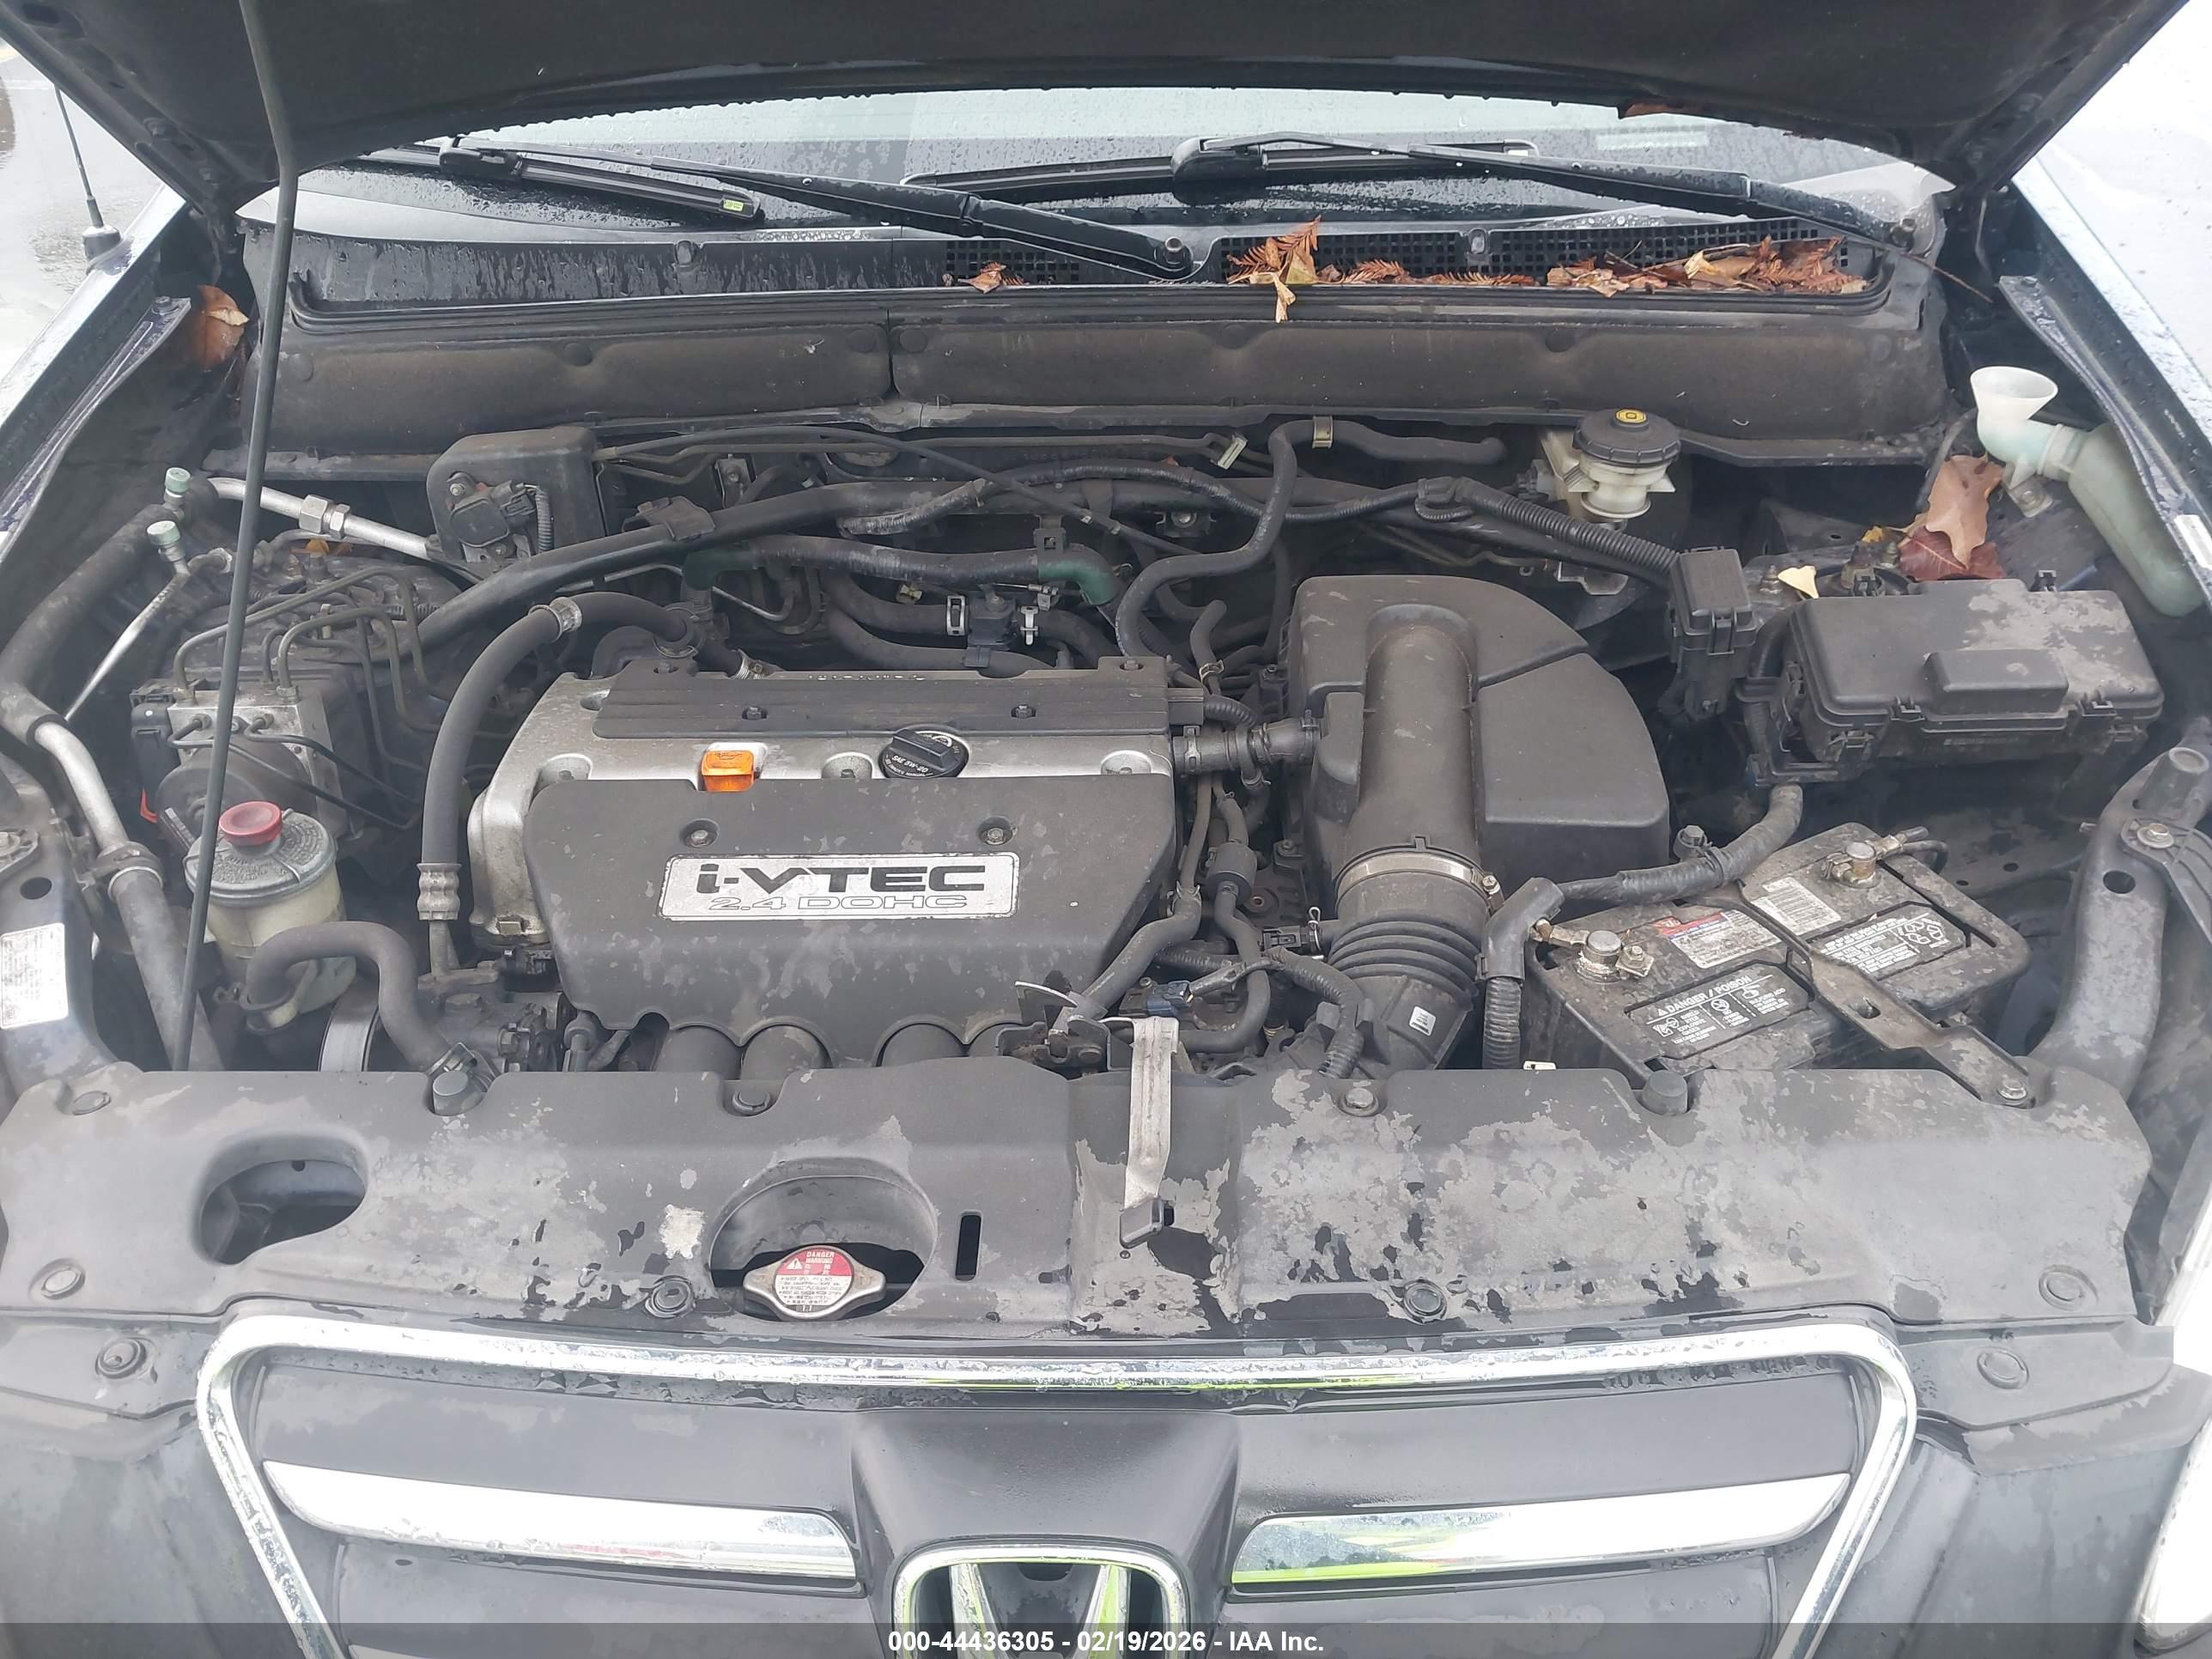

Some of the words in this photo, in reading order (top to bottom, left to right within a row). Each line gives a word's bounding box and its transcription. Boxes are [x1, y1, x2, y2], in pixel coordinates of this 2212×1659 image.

[891, 755, 906, 764] SAE
[696, 864, 985, 894] i-VTEC
[708, 896, 786, 910] 2.4
[798, 895, 968, 909] DOHC
[1667, 993, 1708, 1012] DANGER
[1715, 975, 1753, 994] POISON
